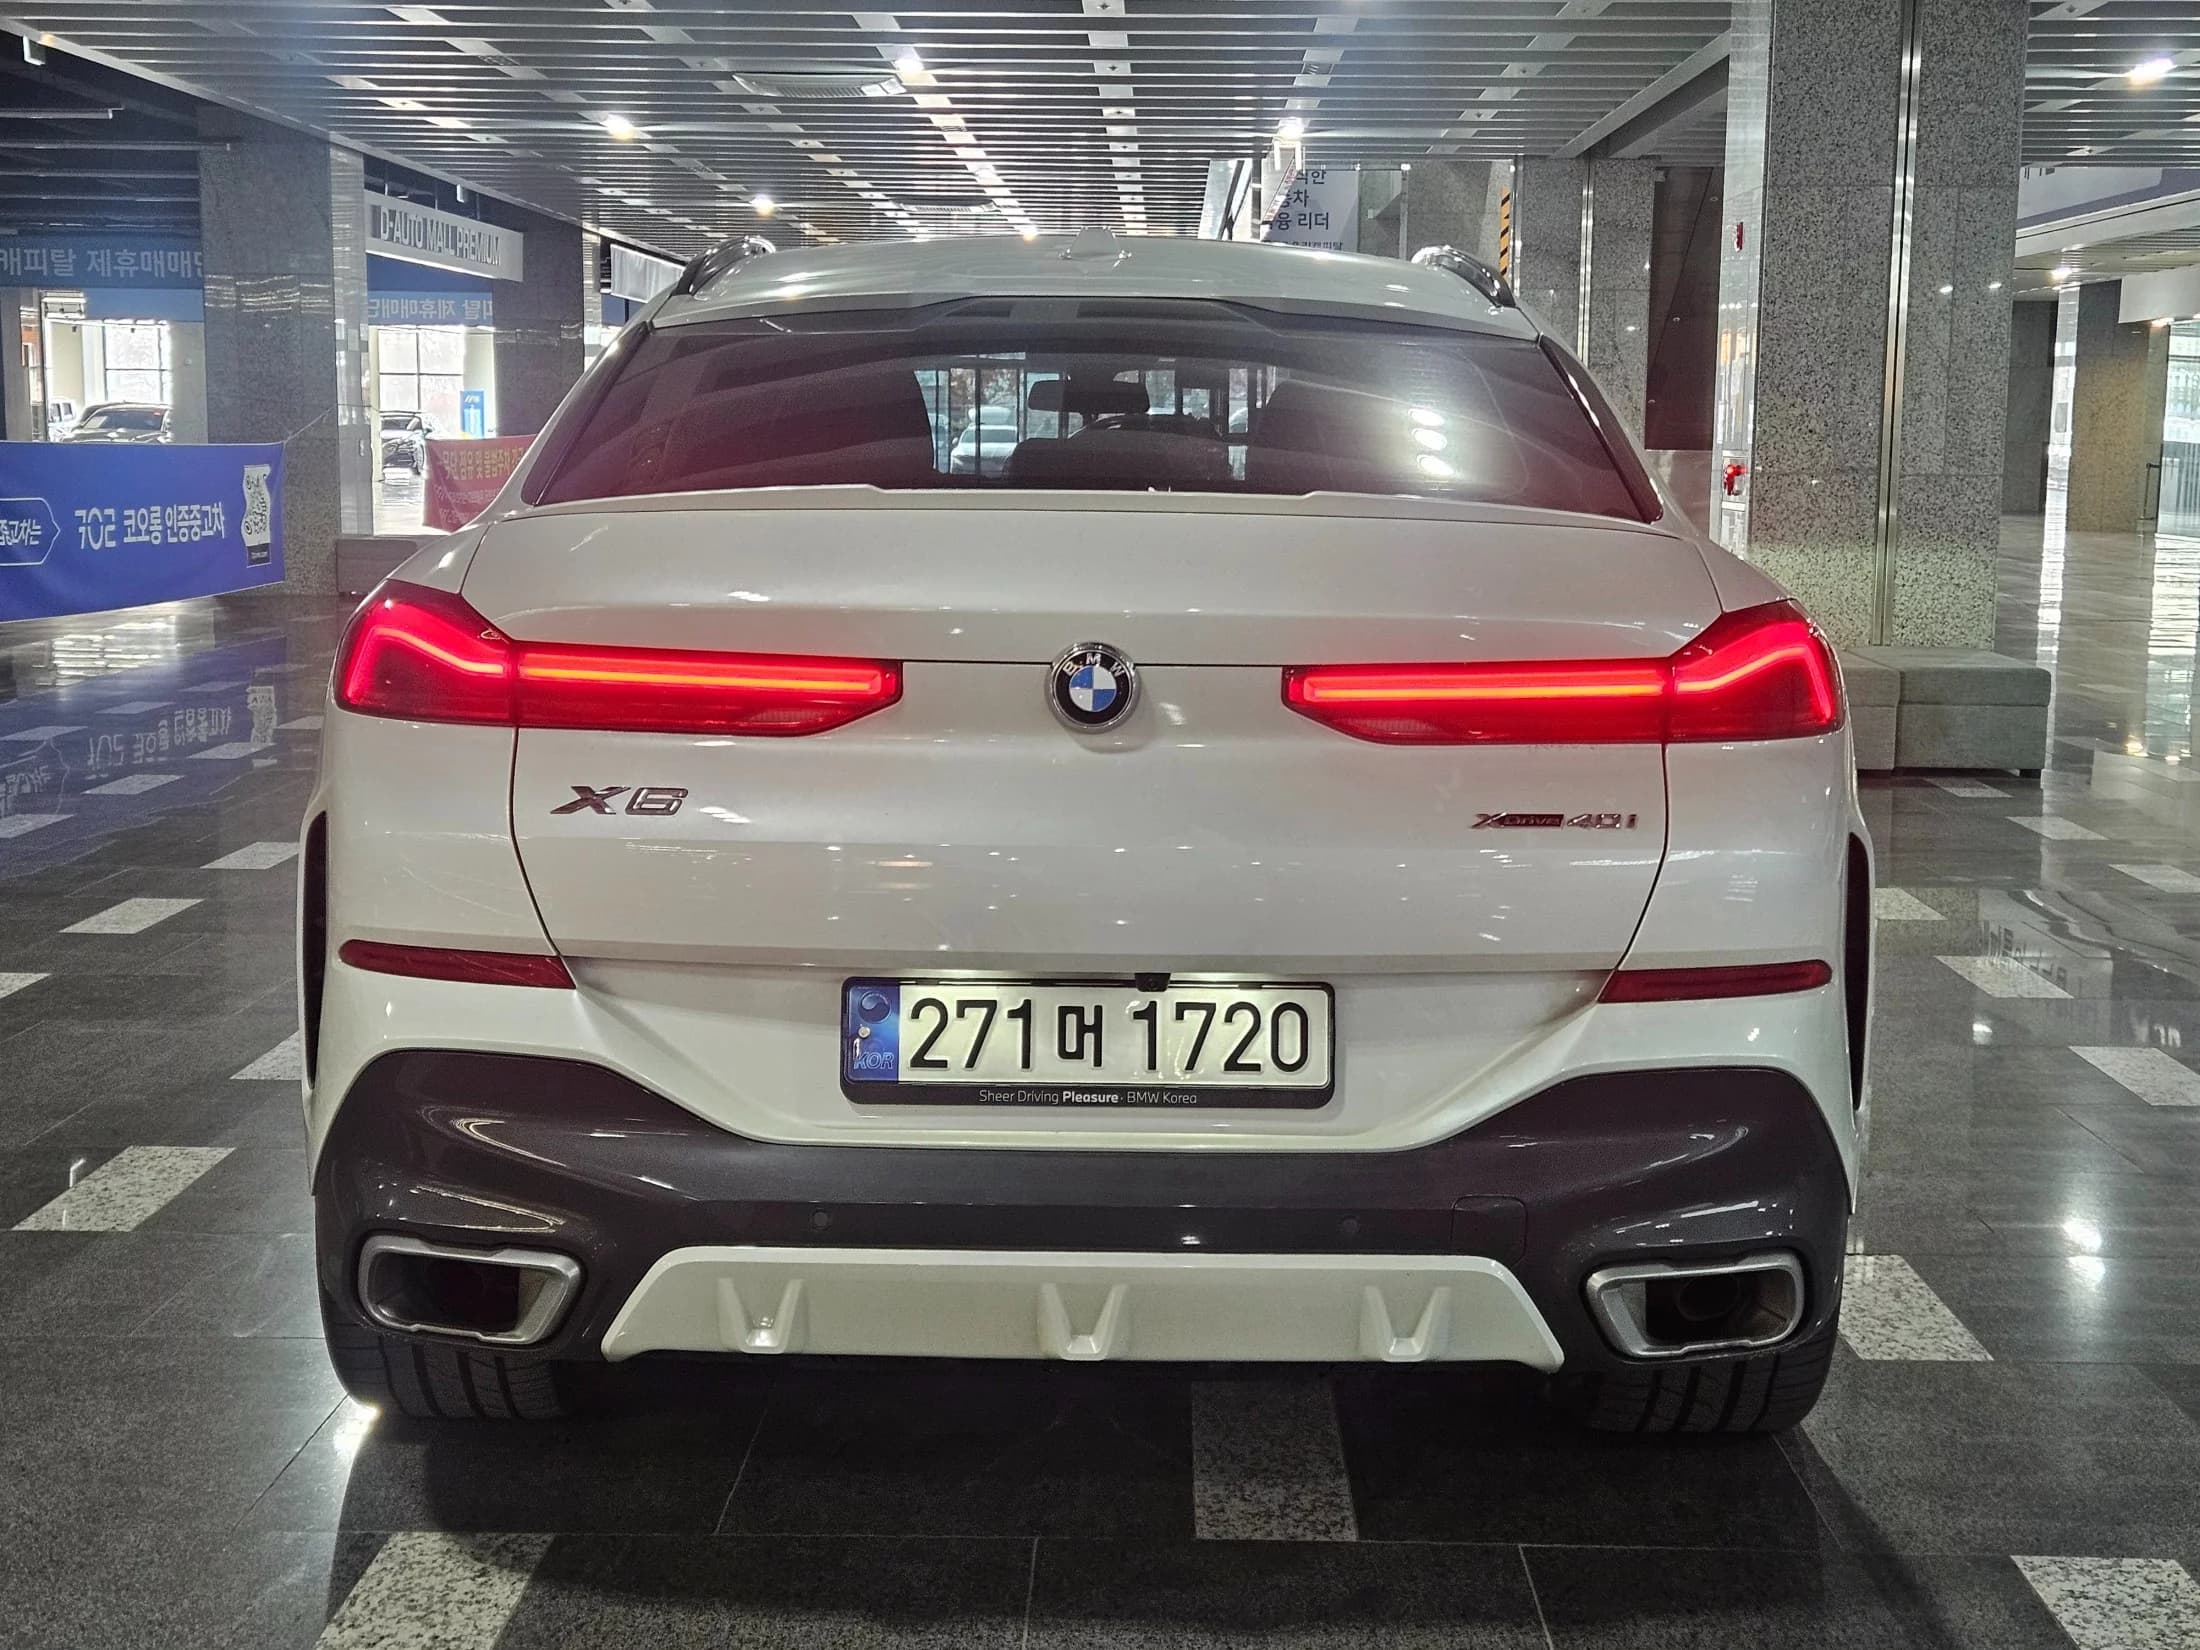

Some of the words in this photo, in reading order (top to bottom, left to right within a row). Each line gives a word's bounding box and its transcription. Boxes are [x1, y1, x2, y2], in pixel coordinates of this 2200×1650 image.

[1297, 212, 1329, 230] 리더
[426, 217, 456, 256] MALL
[456, 226, 501, 266] PREMIUM
[123, 505, 163, 545] 코오롱
[165, 501, 226, 543] 인증중고차
[1063, 653, 1125, 677] BMW
[550, 785, 689, 816] X6
[1132, 1000, 1310, 1073] 1720
[853, 1051, 895, 1070] KOR
[979, 1089, 1015, 1102] Sheer
[1017, 1090, 1059, 1105] Driving
[1127, 1091, 1160, 1104] BMW
[1162, 1091, 1198, 1105] Korea
